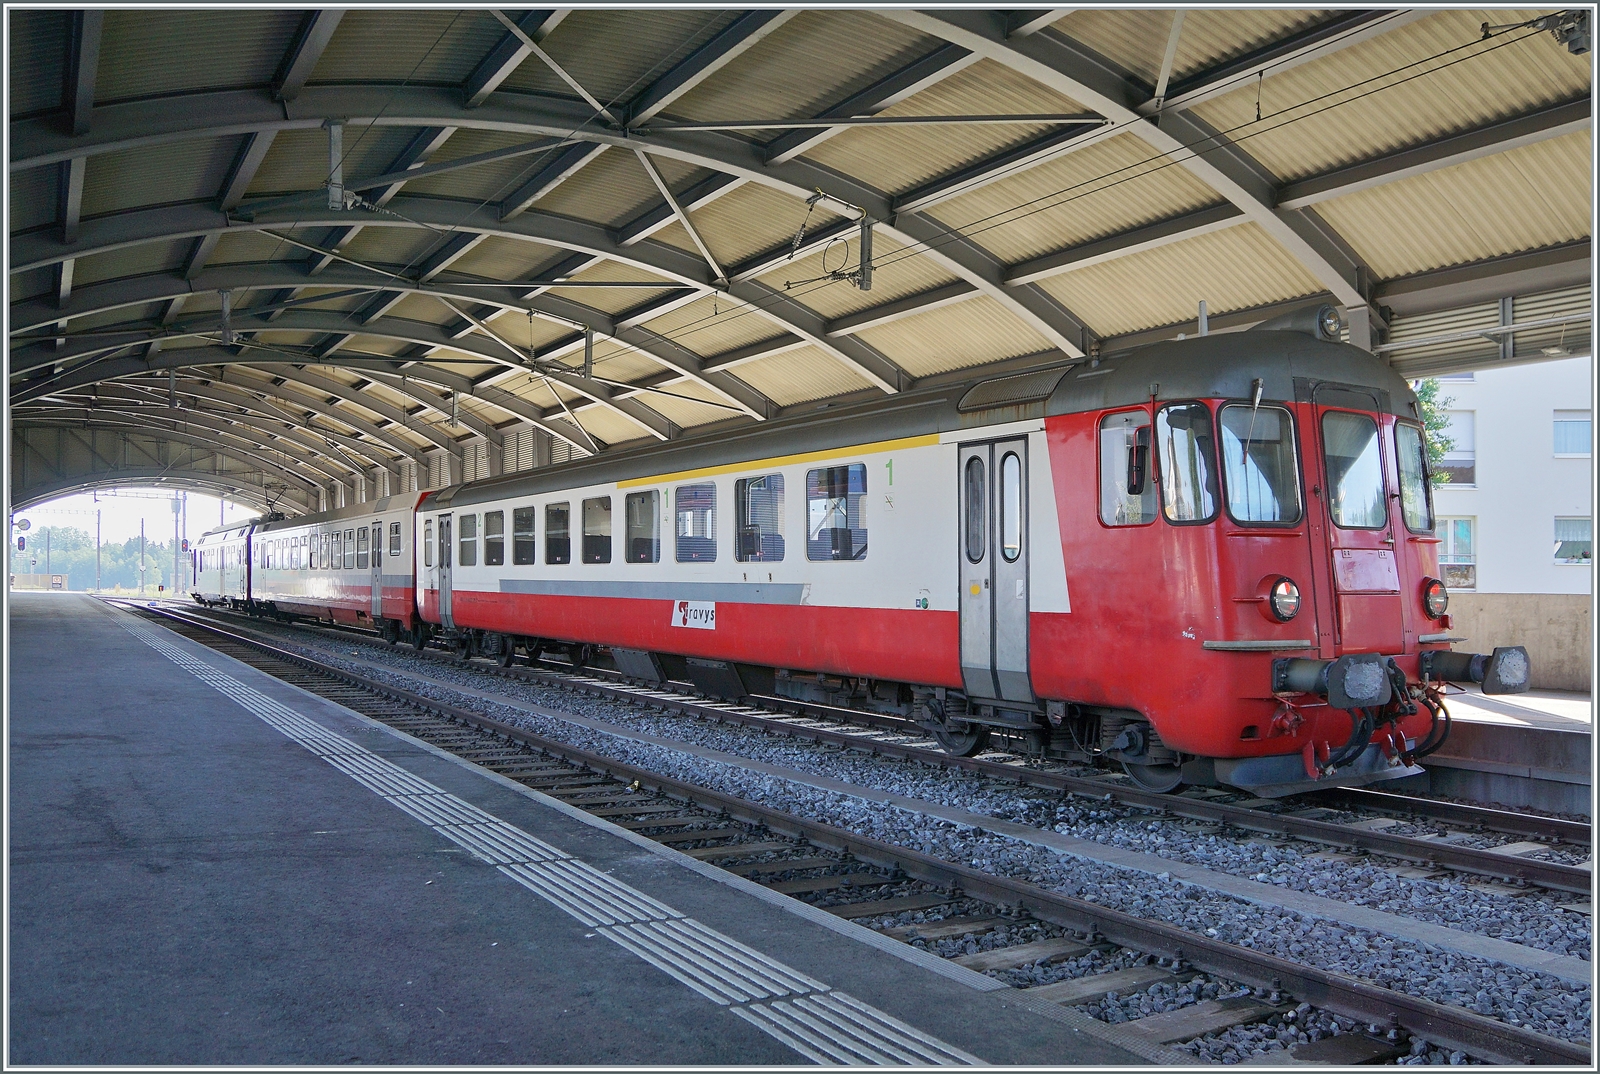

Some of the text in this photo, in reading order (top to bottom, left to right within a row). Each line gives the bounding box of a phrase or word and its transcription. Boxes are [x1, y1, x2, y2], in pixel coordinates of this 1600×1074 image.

[886, 458, 892, 486] 1
[664, 488, 668, 508] 1
[478, 512, 482, 528] 2
